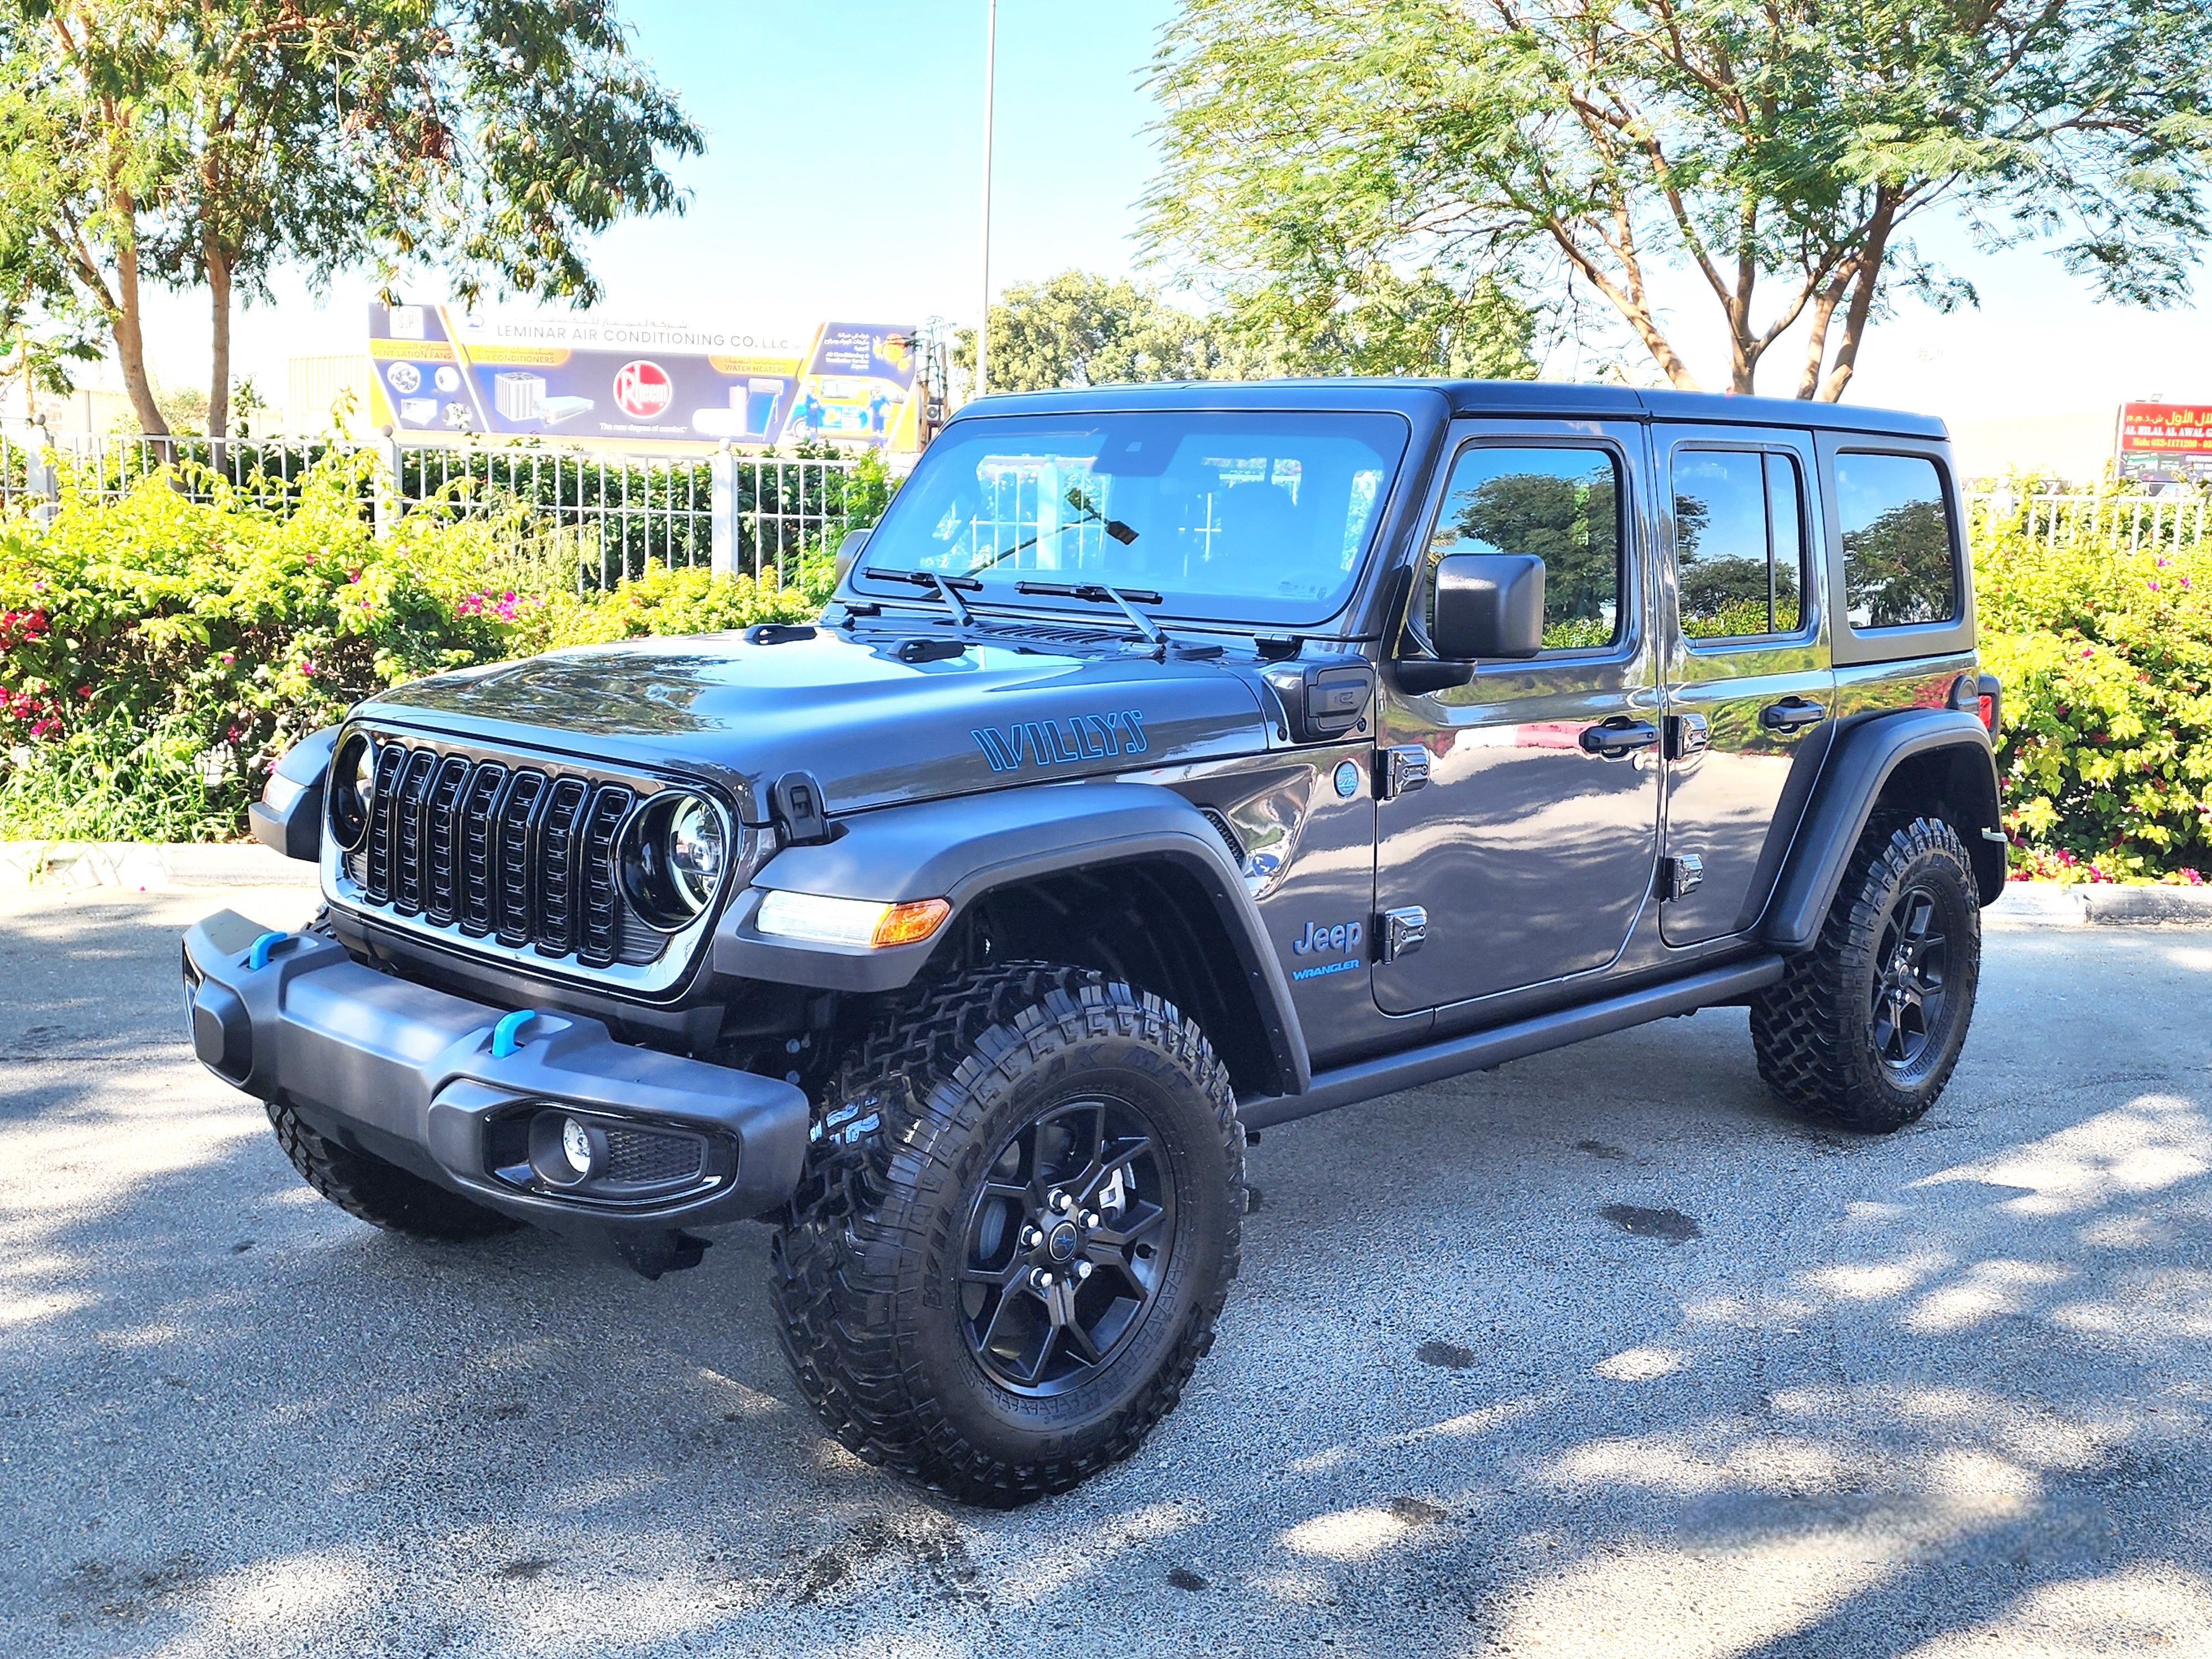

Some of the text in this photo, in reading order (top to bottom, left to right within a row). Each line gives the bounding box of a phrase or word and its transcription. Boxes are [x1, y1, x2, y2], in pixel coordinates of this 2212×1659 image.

[498, 325, 566, 339] LEMINAR
[572, 328, 597, 341] AIR
[604, 330, 724, 346] CONDITIONING
[731, 335, 758, 348] CO.
[372, 349, 427, 358] VENTILATION
[492, 354, 555, 363] CONDITIONERS
[2124, 425, 2137, 435] AL
[2137, 425, 2164, 436] HILAL
[2164, 426, 2178, 437] AL
[2178, 427, 2205, 437] AWAL
[971, 709, 1148, 771] WILLYS
[1293, 921, 1363, 956] Jeep
[1292, 959, 1360, 982] WRANGLER
